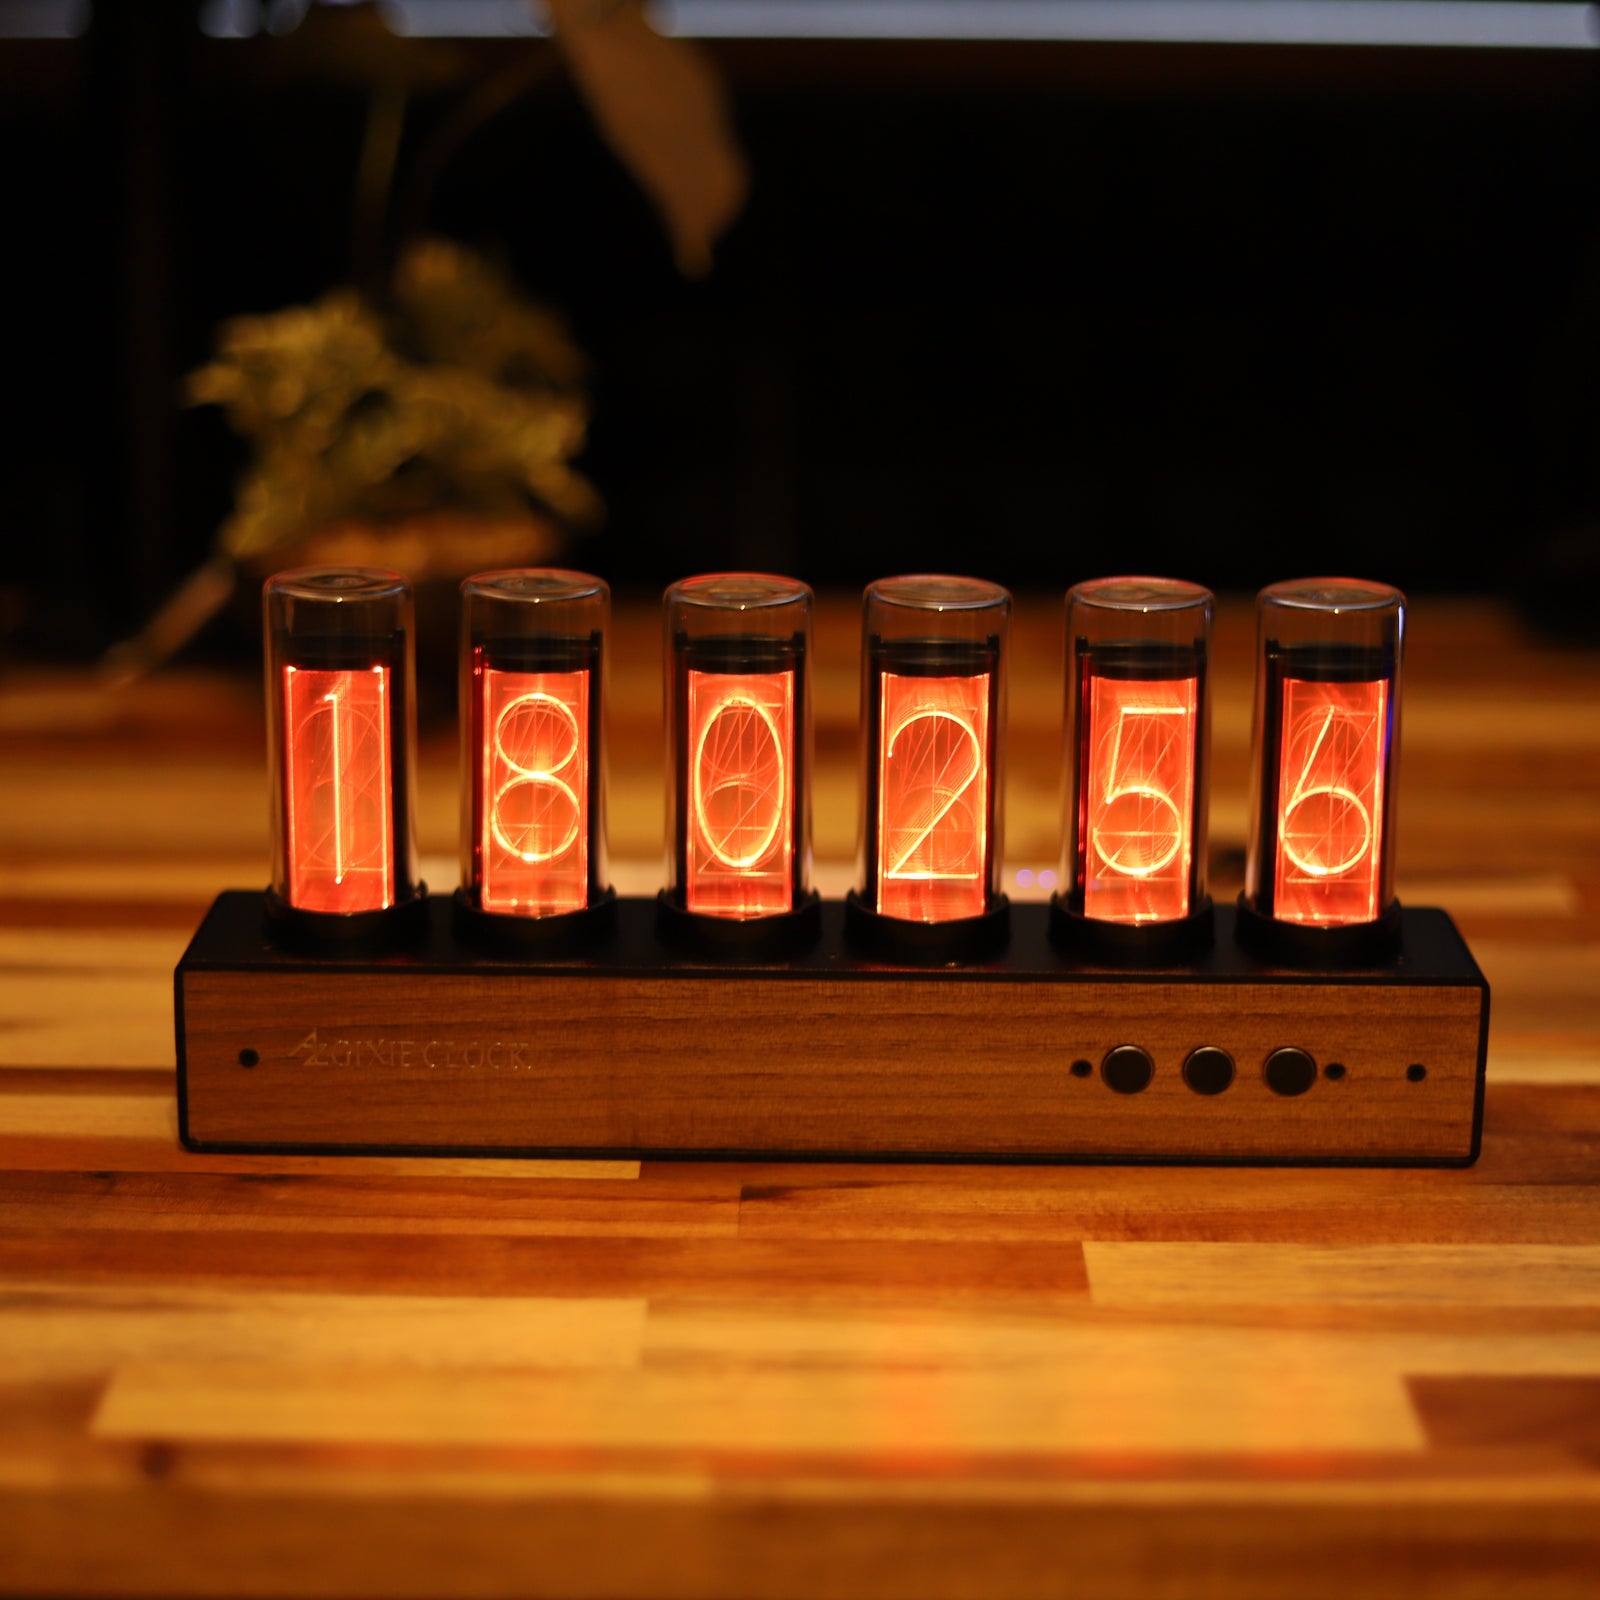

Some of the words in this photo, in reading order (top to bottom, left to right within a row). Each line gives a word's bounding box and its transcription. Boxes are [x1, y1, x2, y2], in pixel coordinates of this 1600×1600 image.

[324, 692, 344, 884] 1
[491, 692, 581, 862] 8
[693, 695, 786, 868] 0
[886, 711, 982, 880] 2
[1092, 706, 1188, 876] 5
[1281, 706, 1372, 876] 6
[423, 1041, 532, 1070] CLOCK
